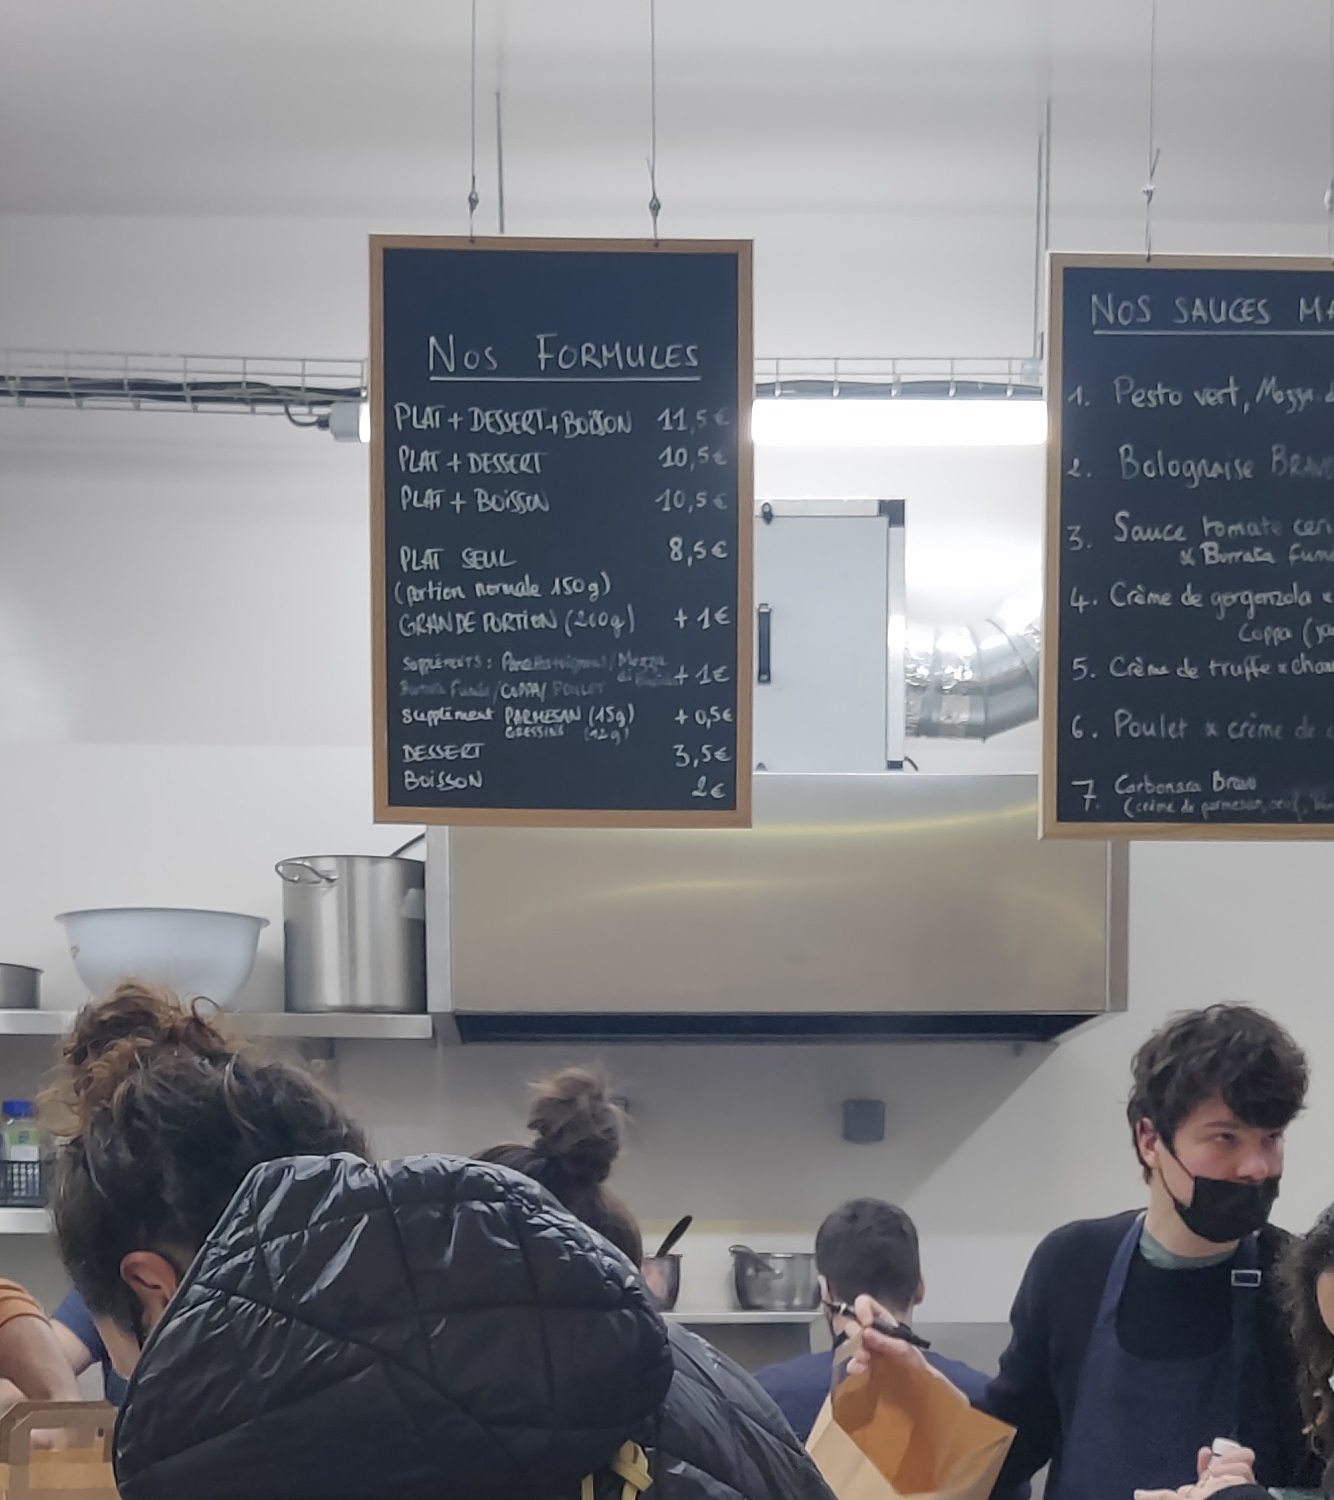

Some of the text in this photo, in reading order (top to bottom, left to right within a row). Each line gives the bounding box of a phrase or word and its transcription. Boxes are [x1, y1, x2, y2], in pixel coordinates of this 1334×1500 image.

[1091, 294, 1150, 326] NOS
[1174, 298, 1271, 325] SAUCES
[1114, 376, 1183, 409] Pesto
[394, 402, 446, 431] PLAT
[399, 445, 441, 473] PLAT
[467, 452, 547, 475] DESSERT
[1119, 444, 1254, 489] Bolognaise
[401, 485, 446, 511] PLAT
[1115, 511, 1187, 542] Sauce
[400, 546, 444, 571] PLAT
[462, 548, 517, 569] SEUL
[1203, 542, 1275, 566] Burrata
[395, 582, 465, 607] (portion
[476, 574, 542, 597] normale
[1069, 588, 1098, 614] 4.
[1110, 582, 1172, 608] Crème
[1181, 584, 1203, 608] de
[1211, 582, 1312, 620] gorgonzola
[399, 611, 476, 637] GRANDE
[483, 610, 558, 632] PORTION
[1238, 622, 1292, 648] Coppa
[1071, 657, 1096, 680] 5.
[1109, 656, 1169, 678] Crème
[1176, 657, 1199, 679] de
[1209, 656, 1271, 683] truffe
[505, 708, 582, 725] PARMESAN
[1071, 715, 1098, 739] 6.
[1114, 709, 1188, 739] Poulet
[402, 743, 485, 761] DESSERT
[404, 770, 483, 791] BOISSON
[1115, 775, 1202, 794] Carbonara
